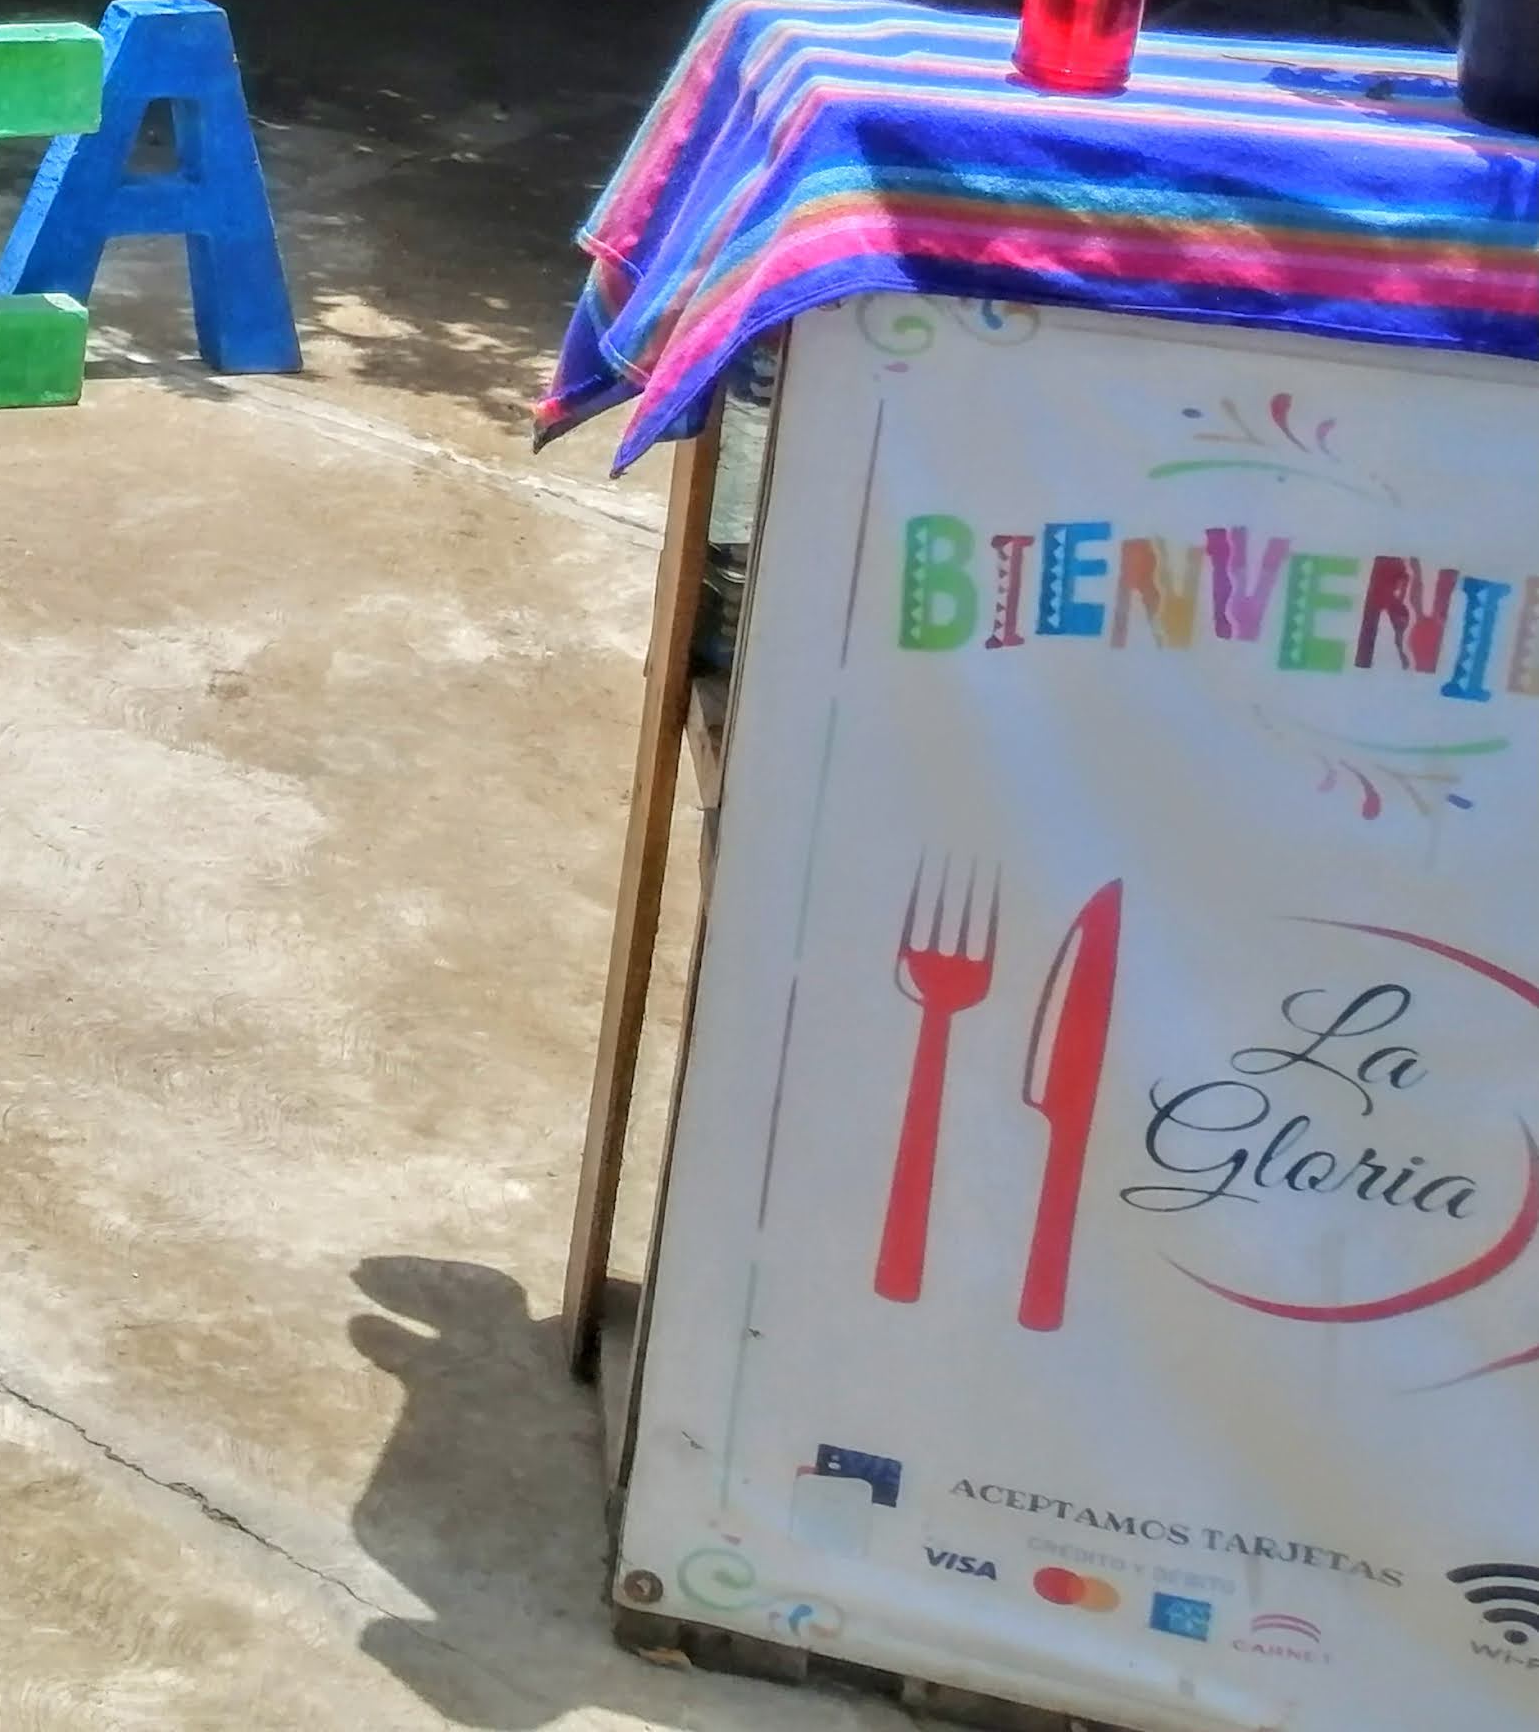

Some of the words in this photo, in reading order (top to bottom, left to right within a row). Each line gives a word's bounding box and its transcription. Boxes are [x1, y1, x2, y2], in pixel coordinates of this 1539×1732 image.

[1231, 983, 1428, 1117] La
[1120, 1077, 1478, 1220] Gloria
[923, 1545, 998, 1581] VISA
[950, 1478, 1190, 1546] ACEPTAMOS
[1202, 1528, 1405, 1589] TARJETAS
